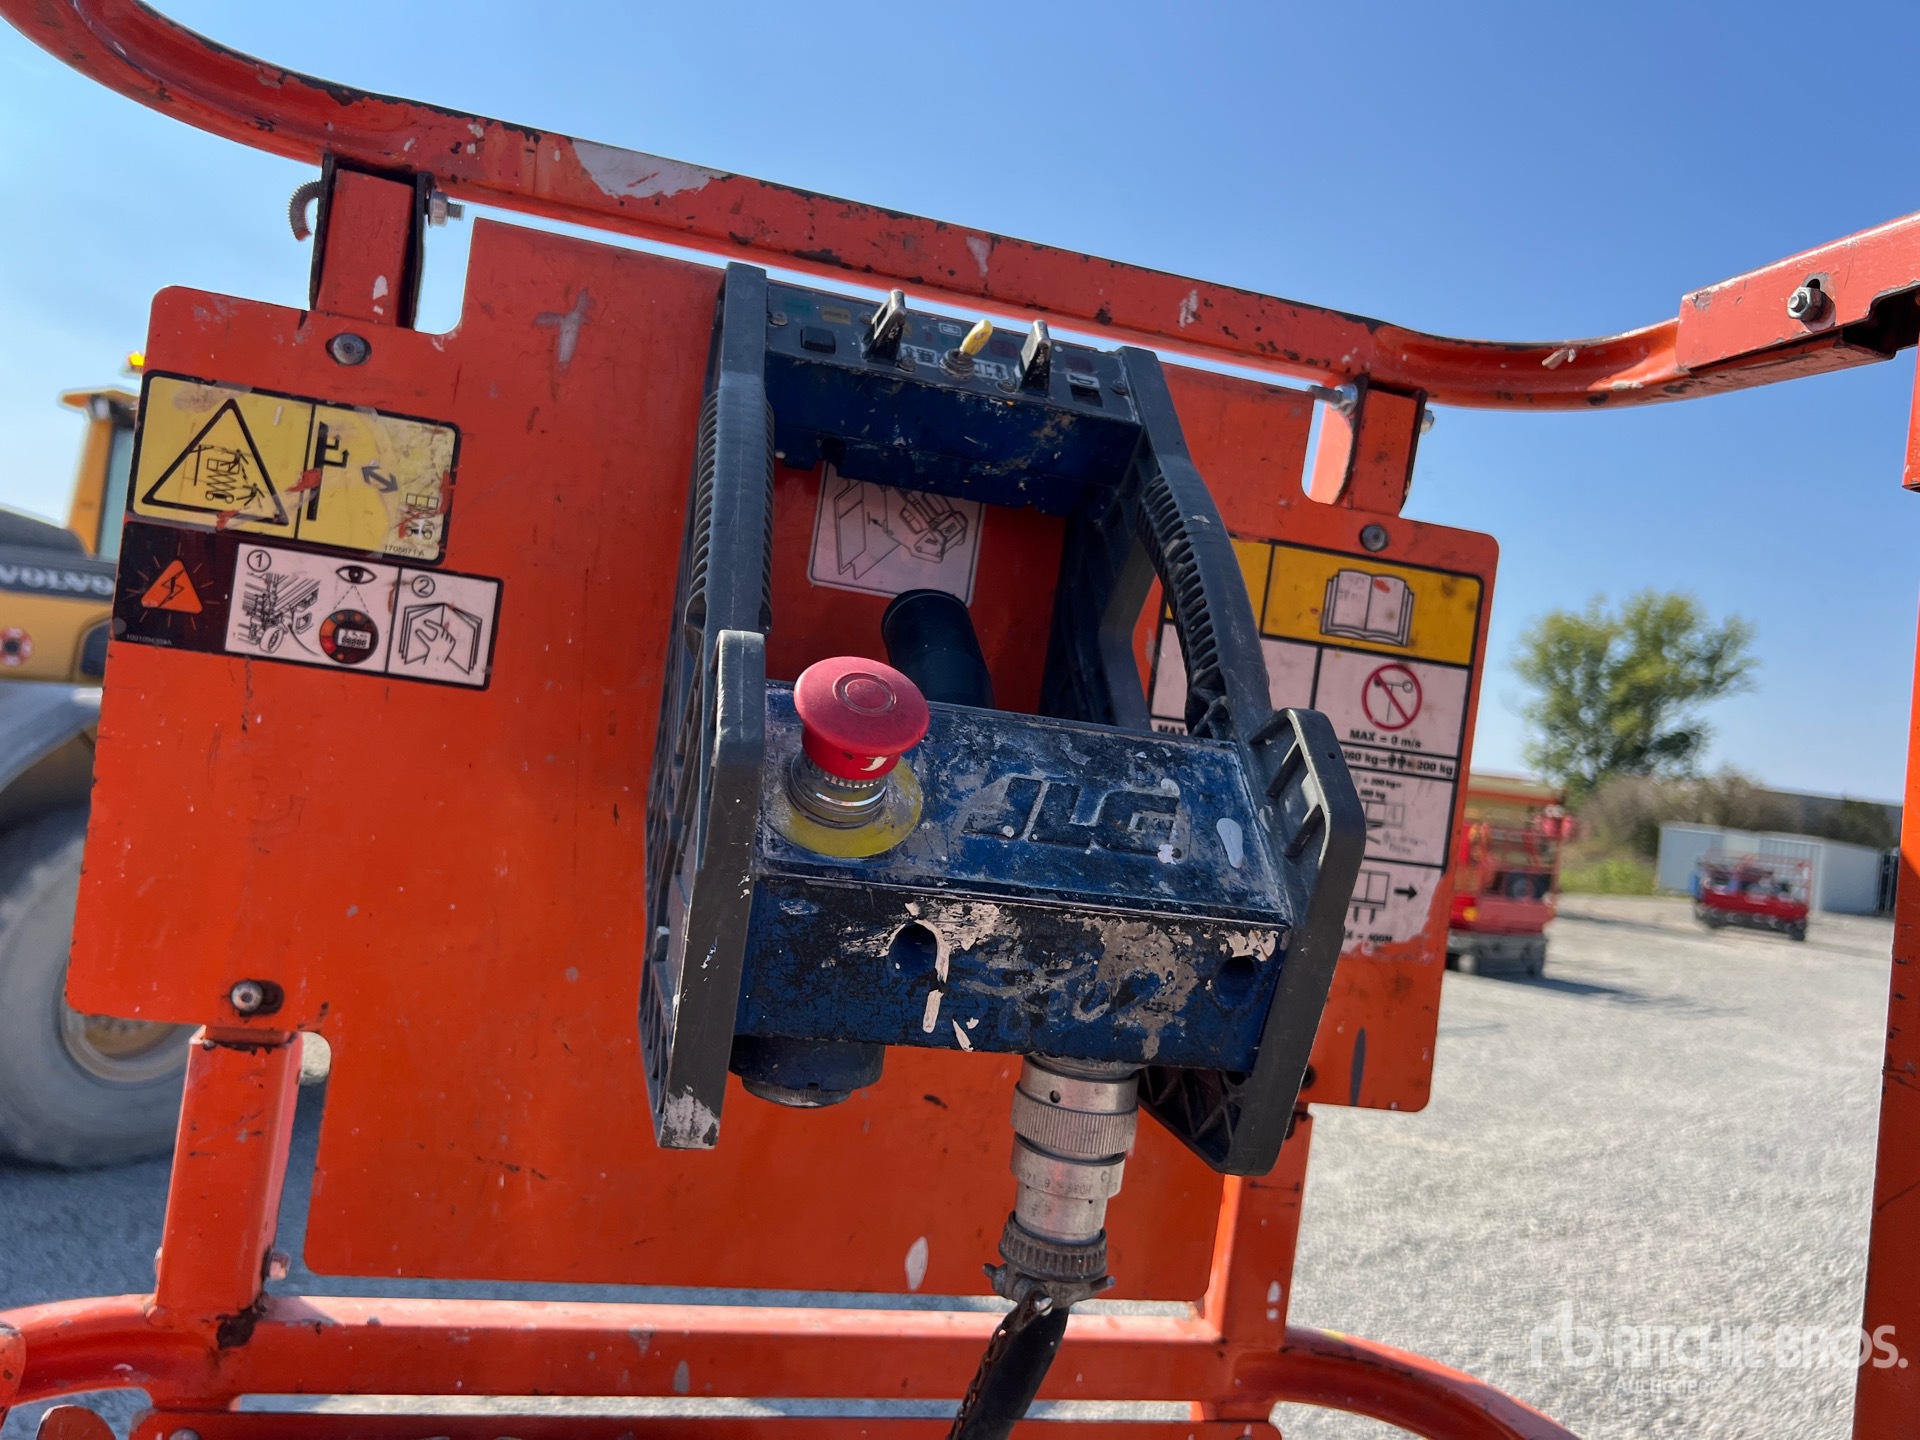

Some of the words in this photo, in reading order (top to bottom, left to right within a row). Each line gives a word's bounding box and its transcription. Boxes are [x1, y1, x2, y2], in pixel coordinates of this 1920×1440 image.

[0, 564, 115, 596] VOLVO
[1349, 729, 1376, 741] MAX
[1401, 738, 1422, 748] m/s
[1440, 765, 1453, 777] kg
